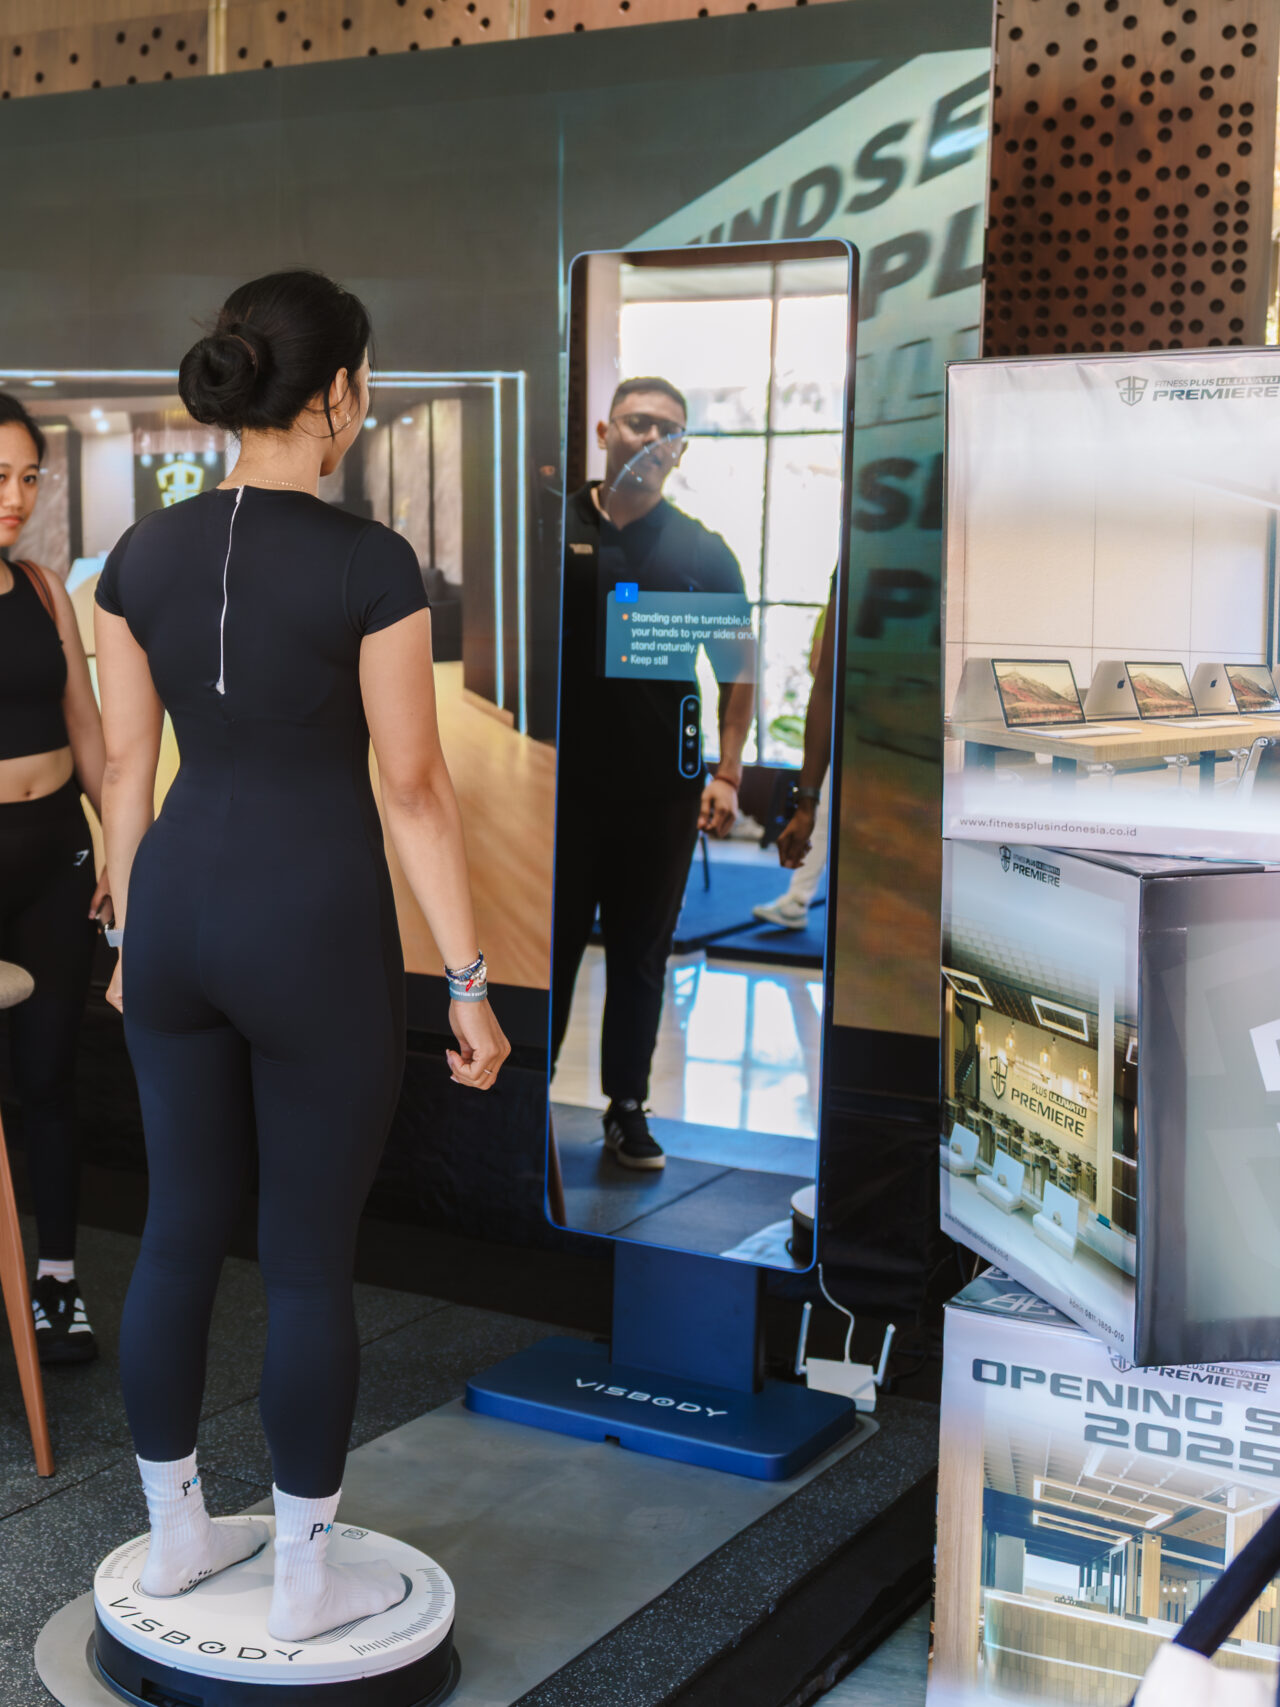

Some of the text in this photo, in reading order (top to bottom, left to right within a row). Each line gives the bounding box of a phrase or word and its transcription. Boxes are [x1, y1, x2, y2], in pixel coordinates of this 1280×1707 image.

[1190, 378, 1215, 387] PLUS
[1152, 386, 1280, 402] PREMIERE
[632, 612, 670, 625] Standing
[671, 615, 683, 624] on
[684, 613, 699, 624] the
[631, 627, 651, 639] your
[652, 626, 679, 638] hands
[680, 628, 690, 638] to
[691, 630, 712, 641] your
[713, 629, 736, 640] sides
[630, 641, 698, 654] stand naturally.
[630, 654, 669, 666] Keep still
[959, 817, 1137, 837] www.fitnessplusindonesia.co.id
[1012, 862, 1060, 888] PREMIERE
[1031, 1082, 1048, 1098] PLUS
[1011, 1087, 1085, 1138] PREMIERE
[1143, 1366, 1269, 1394] PREMIERE
[575, 1377, 728, 1417] VISBODY
[972, 1358, 1223, 1426] OPENING
[1084, 1411, 1280, 1478] 2025
[108, 1596, 304, 1662] VISBODY
